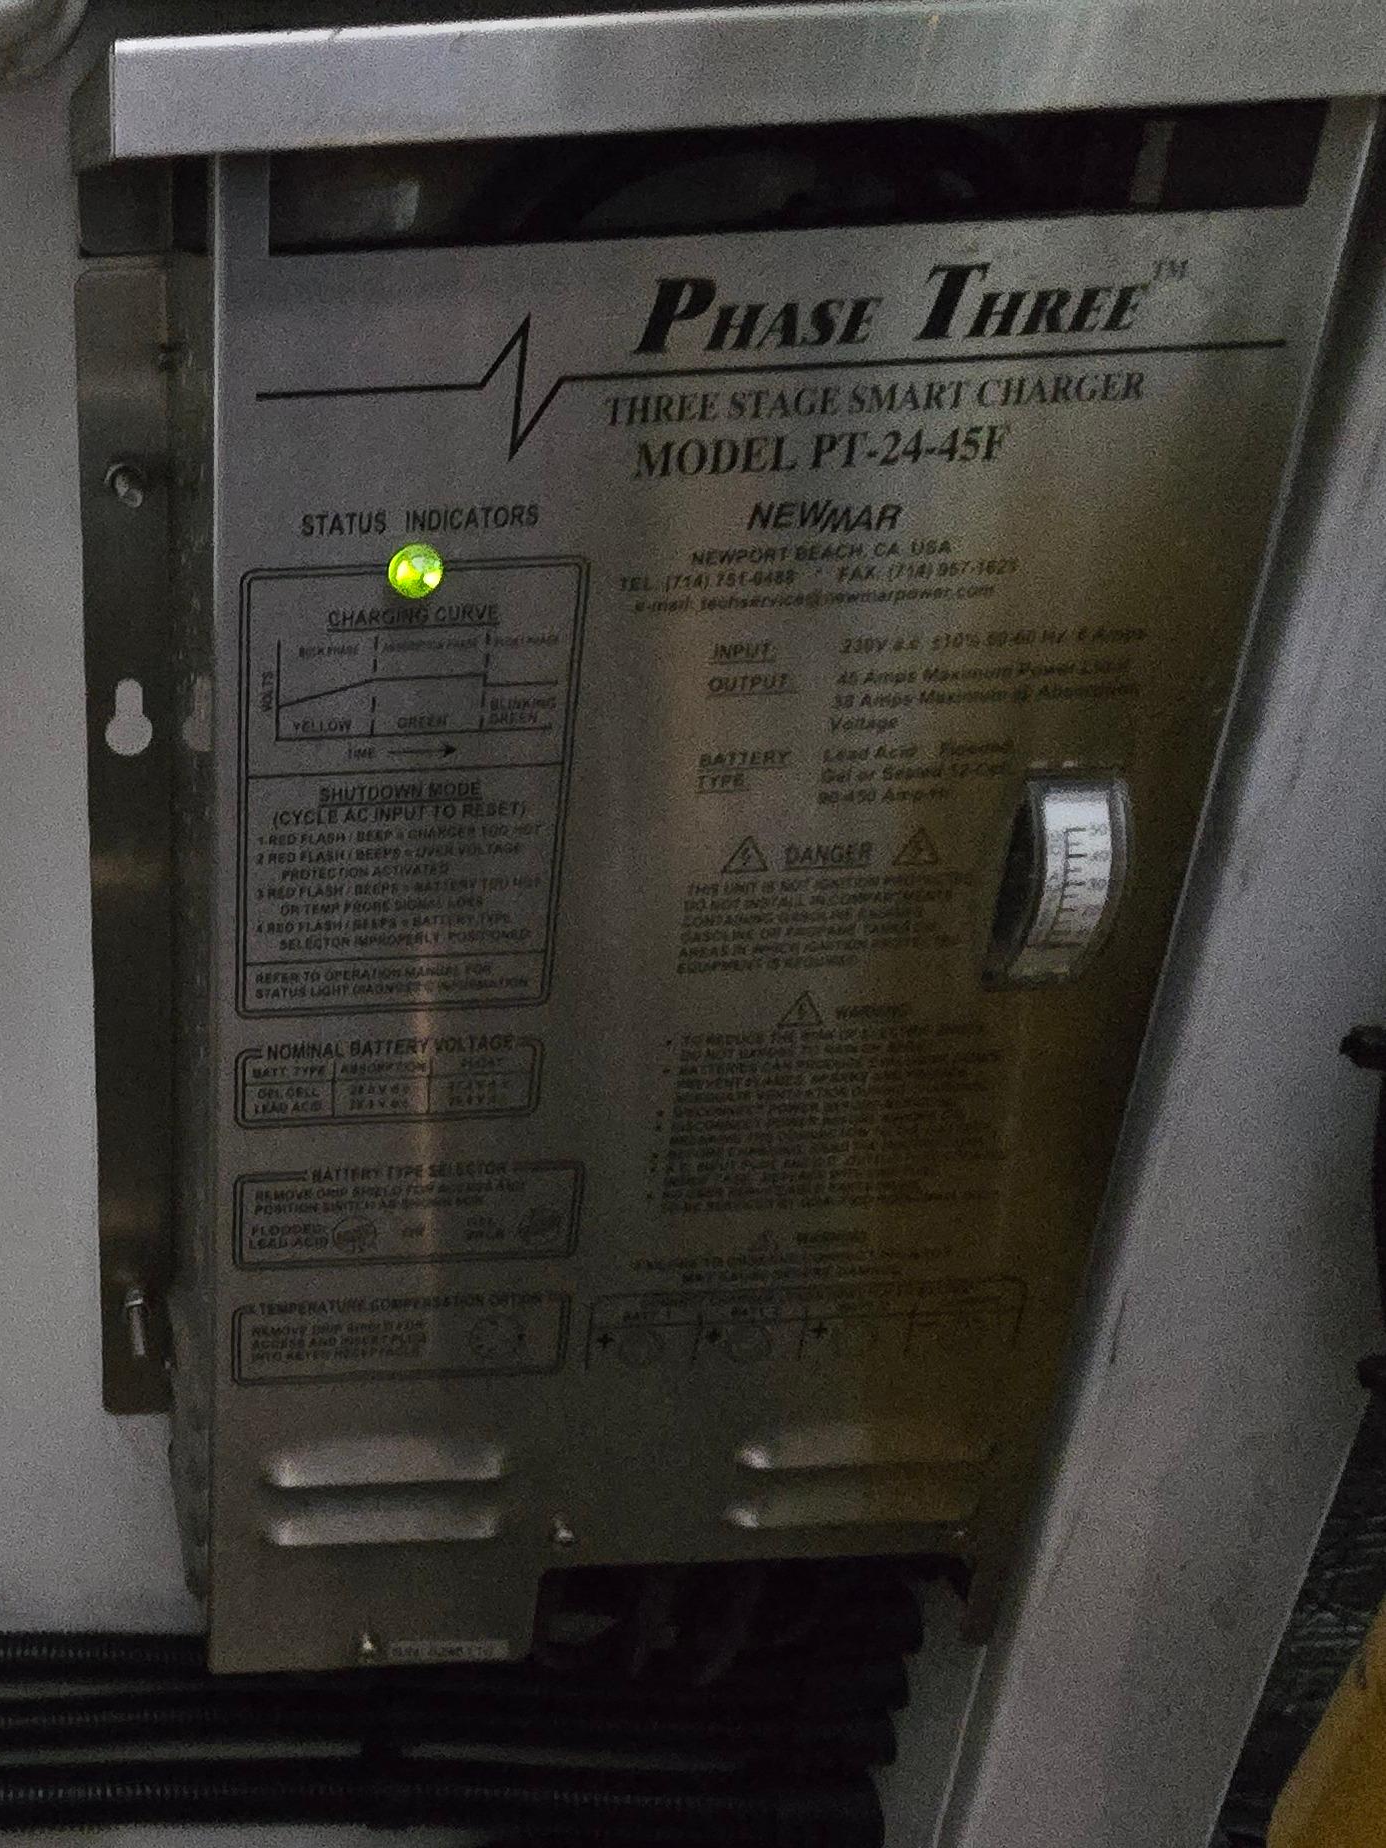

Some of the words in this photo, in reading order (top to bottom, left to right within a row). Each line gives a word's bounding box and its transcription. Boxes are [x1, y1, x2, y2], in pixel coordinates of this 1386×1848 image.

[633, 276, 885, 355] PHASE
[914, 264, 1150, 341] THREE
[607, 392, 719, 427] THREE
[722, 386, 841, 422] STAGE
[846, 379, 971, 416] SMART
[976, 371, 1145, 408] CHARGER
[632, 434, 798, 480] MODEL
[810, 426, 1014, 470] PT-24-45F
[301, 510, 388, 537] STATUS
[405, 505, 540, 532] INDICATORS
[745, 499, 903, 534] NEWMAR
[691, 546, 789, 566] NEWPORT
[911, 539, 953, 556] USA
[327, 607, 429, 628] CHARGING
[437, 604, 499, 623] CURVE
[293, 720, 352, 731] YELLOW
[397, 716, 447, 730] GREEN
[699, 748, 792, 768] BATTERY
[319, 783, 423, 802] SHUTDOWN
[428, 781, 481, 798] MODE
[273, 808, 338, 828] (CYCLE
[343, 807, 368, 825] AC
[373, 804, 425, 824] INPUT
[432, 803, 456, 822] TO
[462, 801, 526, 820] RESET)
[268, 834, 297, 846] RED
[300, 832, 345, 844] FLASH
[268, 852, 296, 864] RED
[299, 850, 344, 863] FLASH
[784, 841, 873, 865] DANGER
[268, 887, 295, 899] RED
[299, 885, 343, 898] FLASH
[267, 922, 294, 934] RED
[255, 971, 300, 984] REFER
[255, 986, 306, 999] STATUS
[310, 985, 348, 997] LIGHT
[267, 1043, 345, 1061] NOMINAL
[350, 1038, 429, 1057] BATTERY
